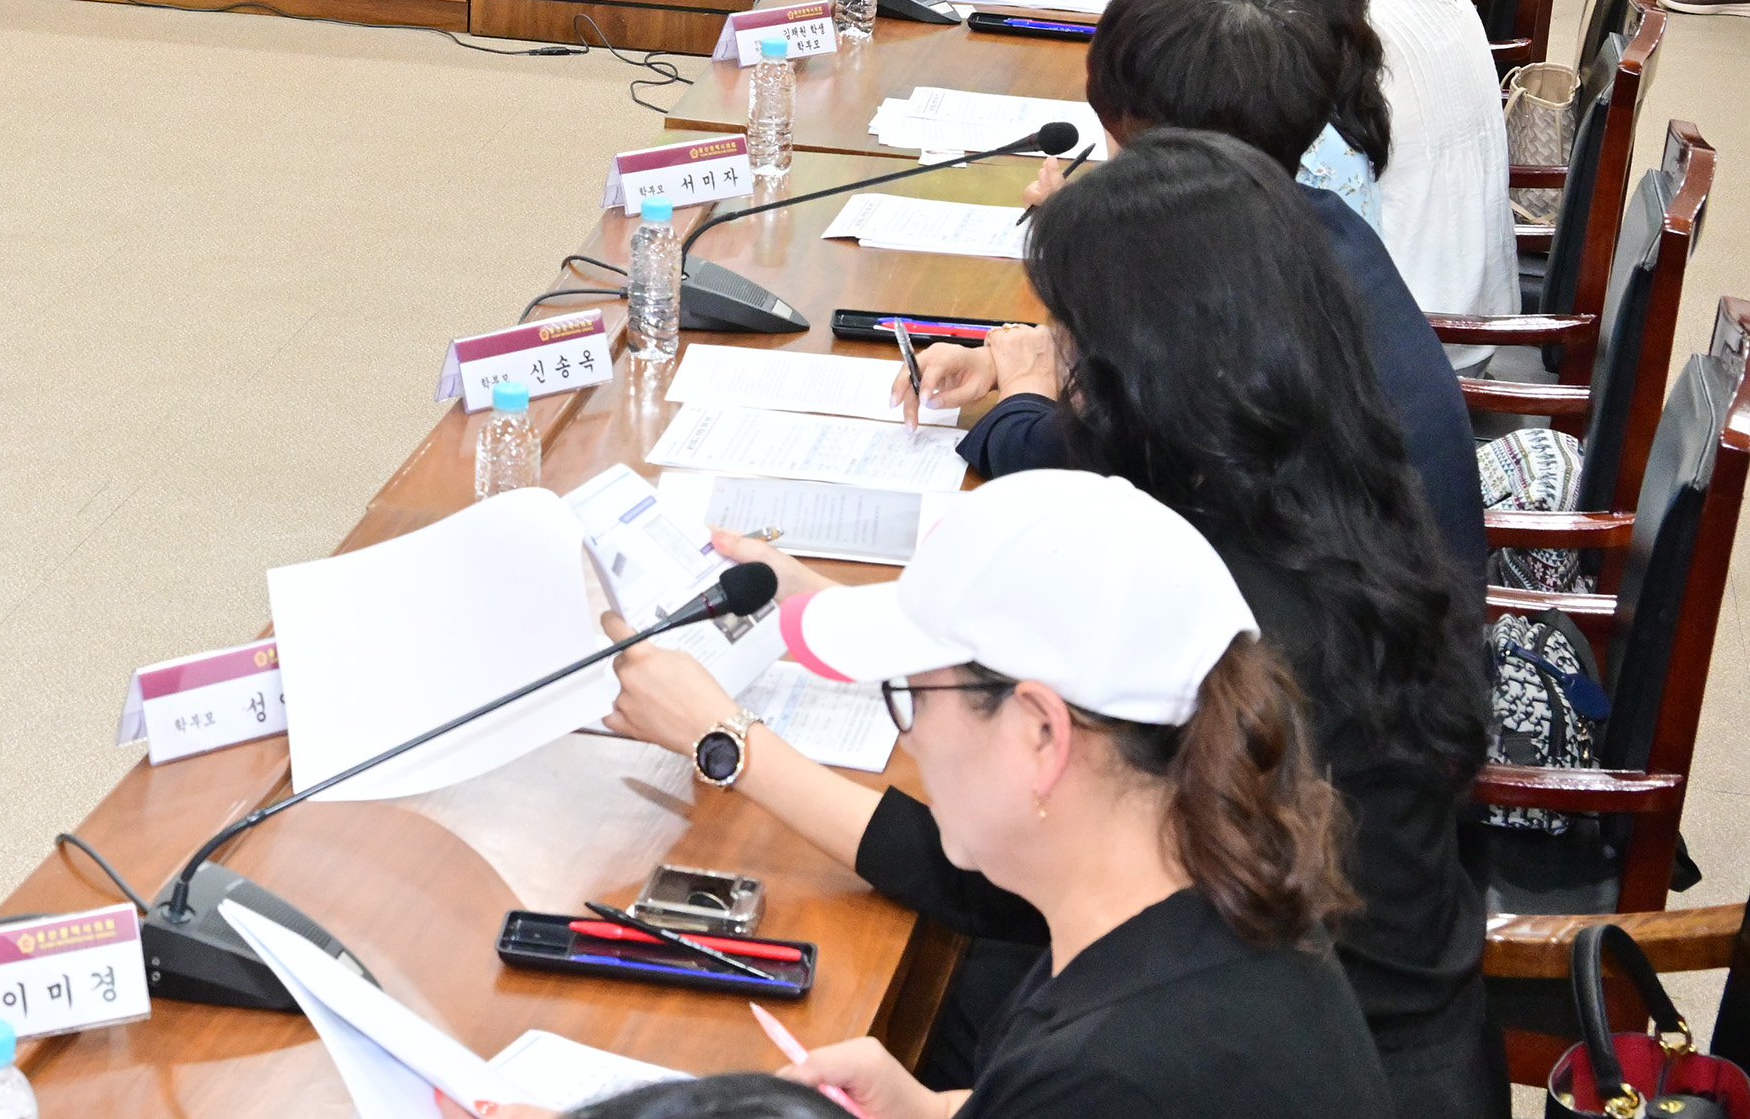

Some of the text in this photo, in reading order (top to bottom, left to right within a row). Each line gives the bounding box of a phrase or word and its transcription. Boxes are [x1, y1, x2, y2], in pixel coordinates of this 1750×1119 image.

[796, 39, 821, 52] 학부모
[639, 167, 739, 197] 학부모 서미자
[530, 349, 595, 384] 신송옥
[174, 711, 216, 732] 학부모
[2, 966, 118, 1017] 이미경
